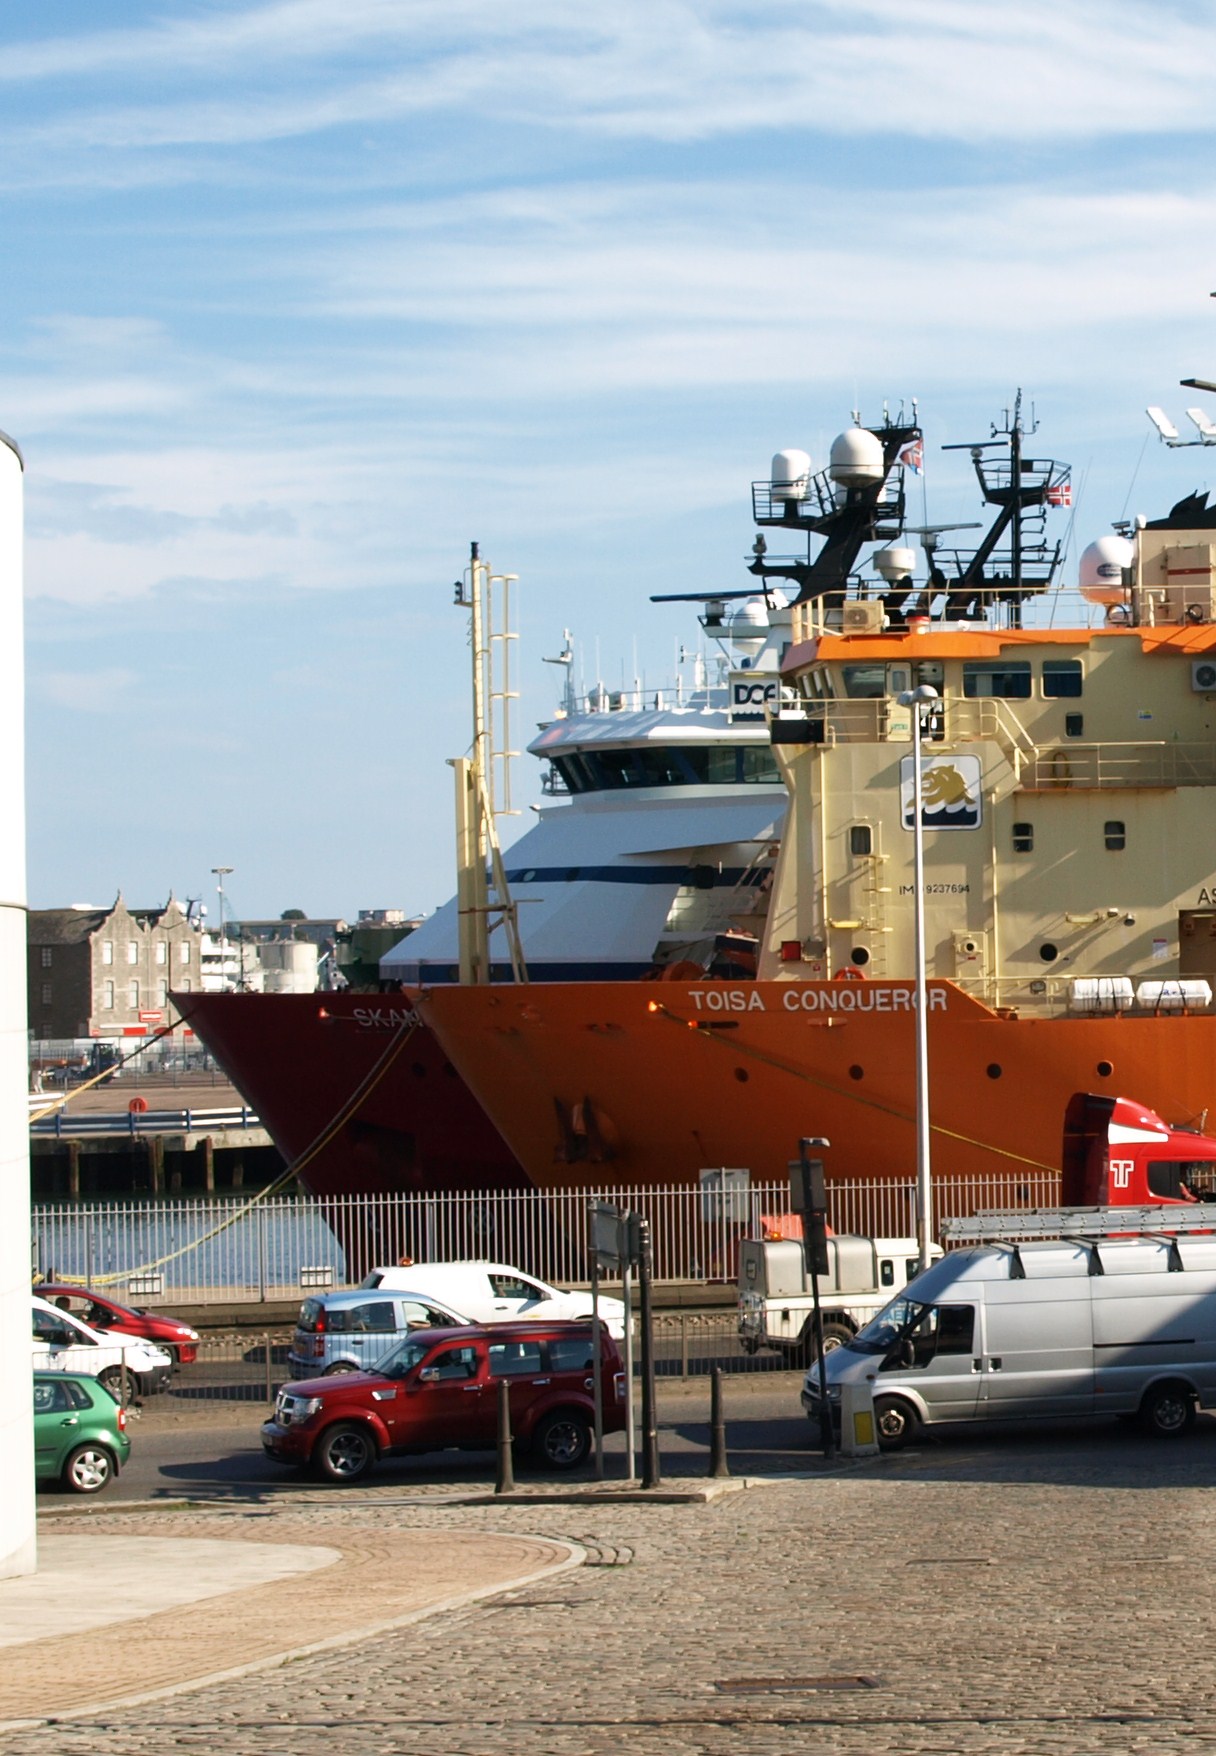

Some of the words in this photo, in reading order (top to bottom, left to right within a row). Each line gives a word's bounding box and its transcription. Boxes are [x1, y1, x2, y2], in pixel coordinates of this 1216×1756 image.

[926, 883, 970, 893] 9237694
[688, 991, 765, 1011] TOISA
[783, 988, 947, 1011] CONQUEROR
